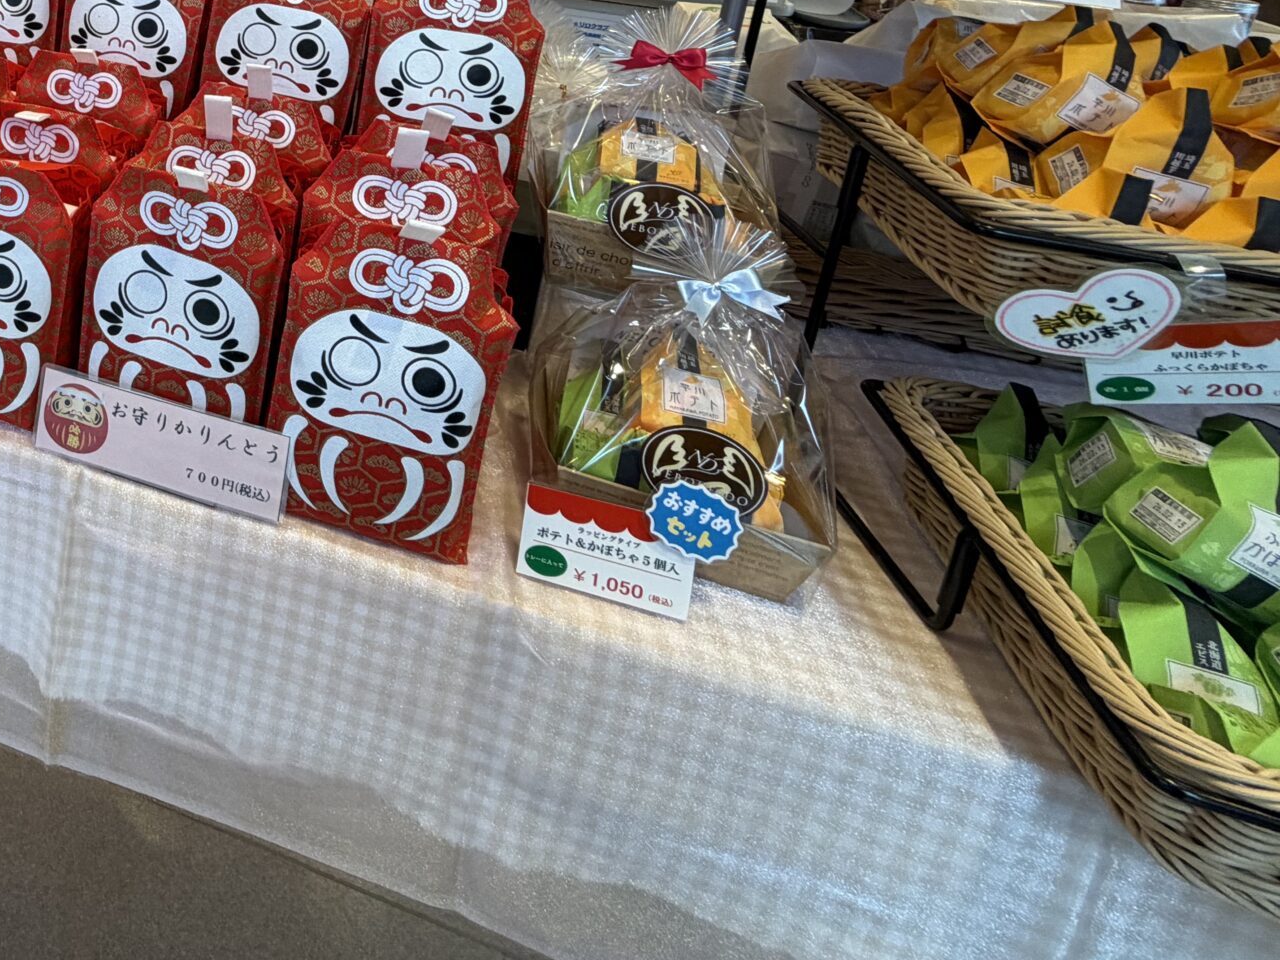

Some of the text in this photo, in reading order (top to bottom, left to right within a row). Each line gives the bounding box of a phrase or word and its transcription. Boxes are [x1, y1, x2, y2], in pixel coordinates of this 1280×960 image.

[1033, 302, 1106, 337] 試食
[1055, 315, 1152, 350] あります!
[1154, 363, 1268, 373] ふっくらかぼちゃ
[1170, 349, 1242, 360] 早川ポテト
[111, 401, 280, 464] お守りかりんとう
[663, 490, 734, 536] おすすめ
[577, 526, 641, 548] ラッピングタイプ
[666, 516, 714, 549] セット
[537, 526, 680, 576] ポテト&かぼちゃ5個入
